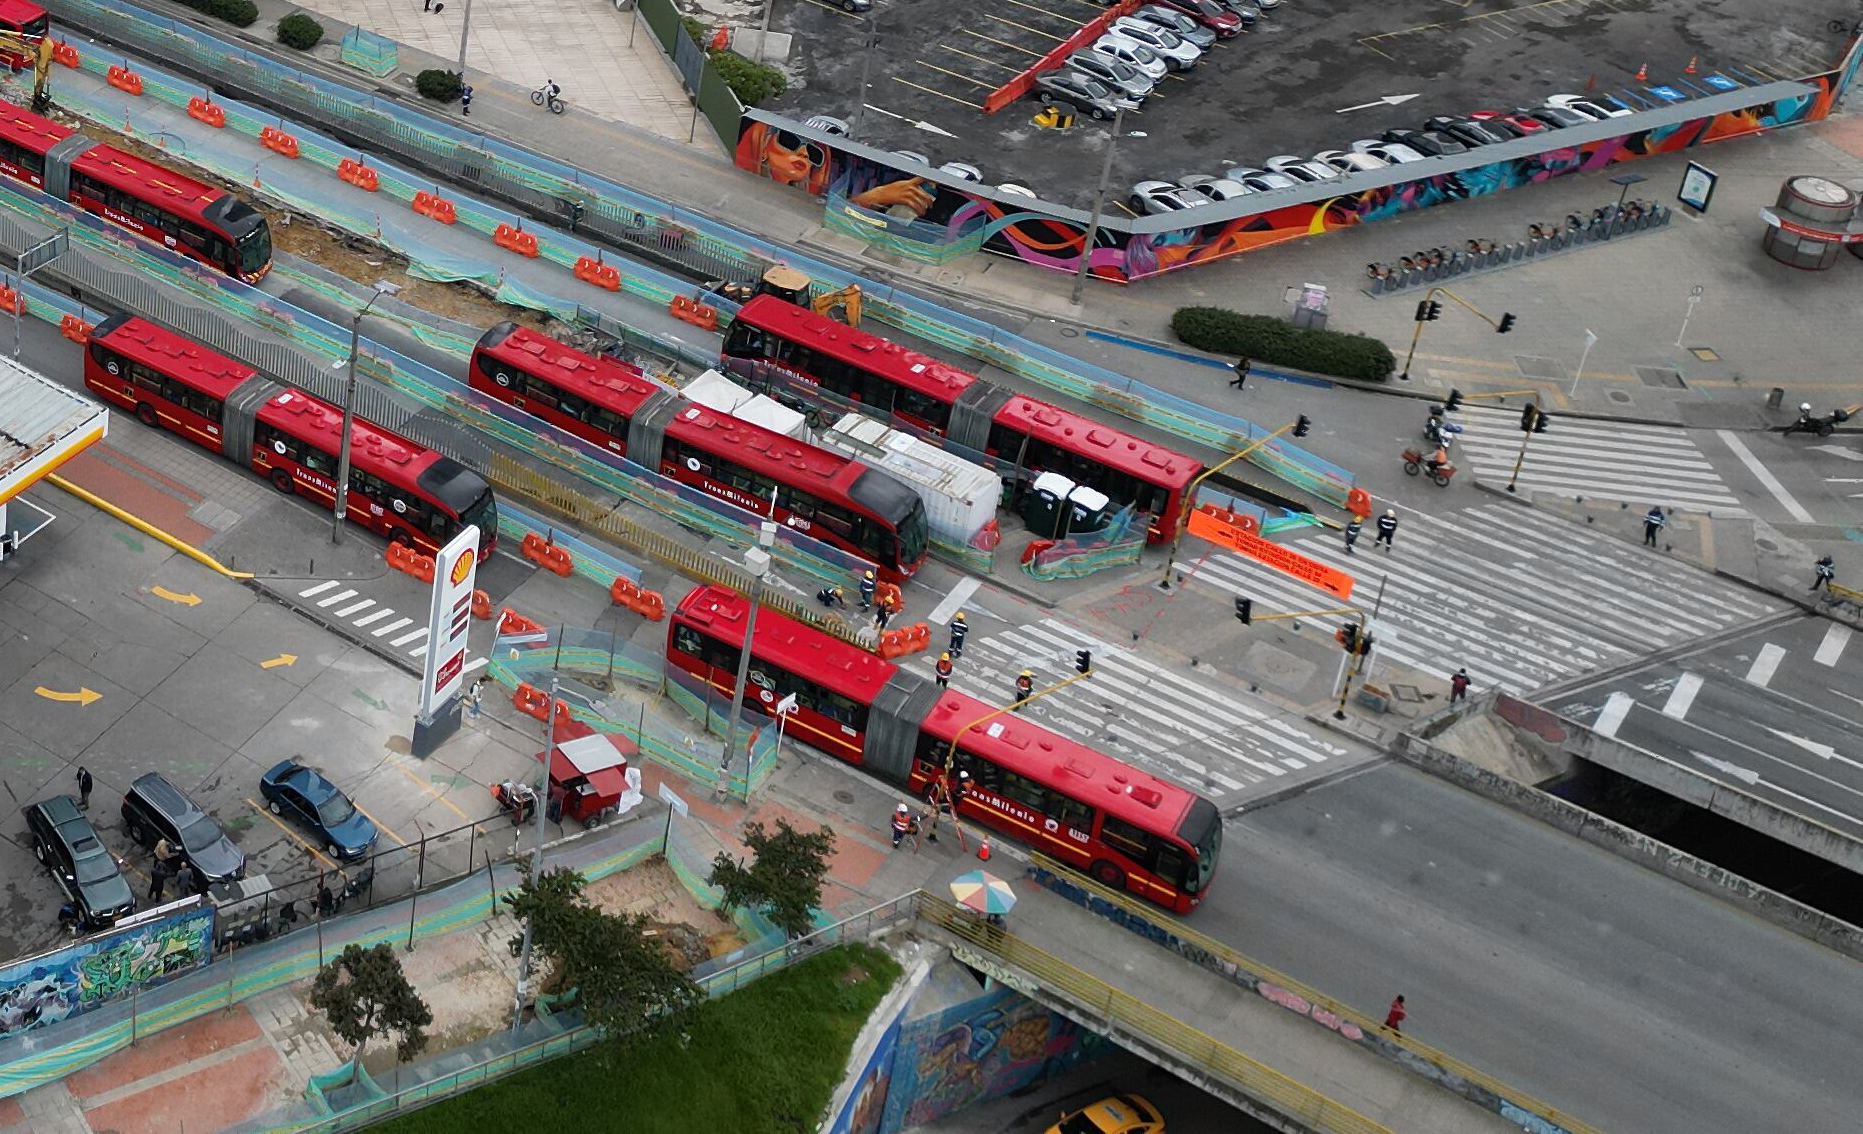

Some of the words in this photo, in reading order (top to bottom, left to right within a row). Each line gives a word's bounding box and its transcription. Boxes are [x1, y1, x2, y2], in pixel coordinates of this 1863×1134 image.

[296, 468, 338, 494] TransMilen
[704, 480, 759, 509] TransMilenio
[972, 790, 1035, 823] ansMilenio
